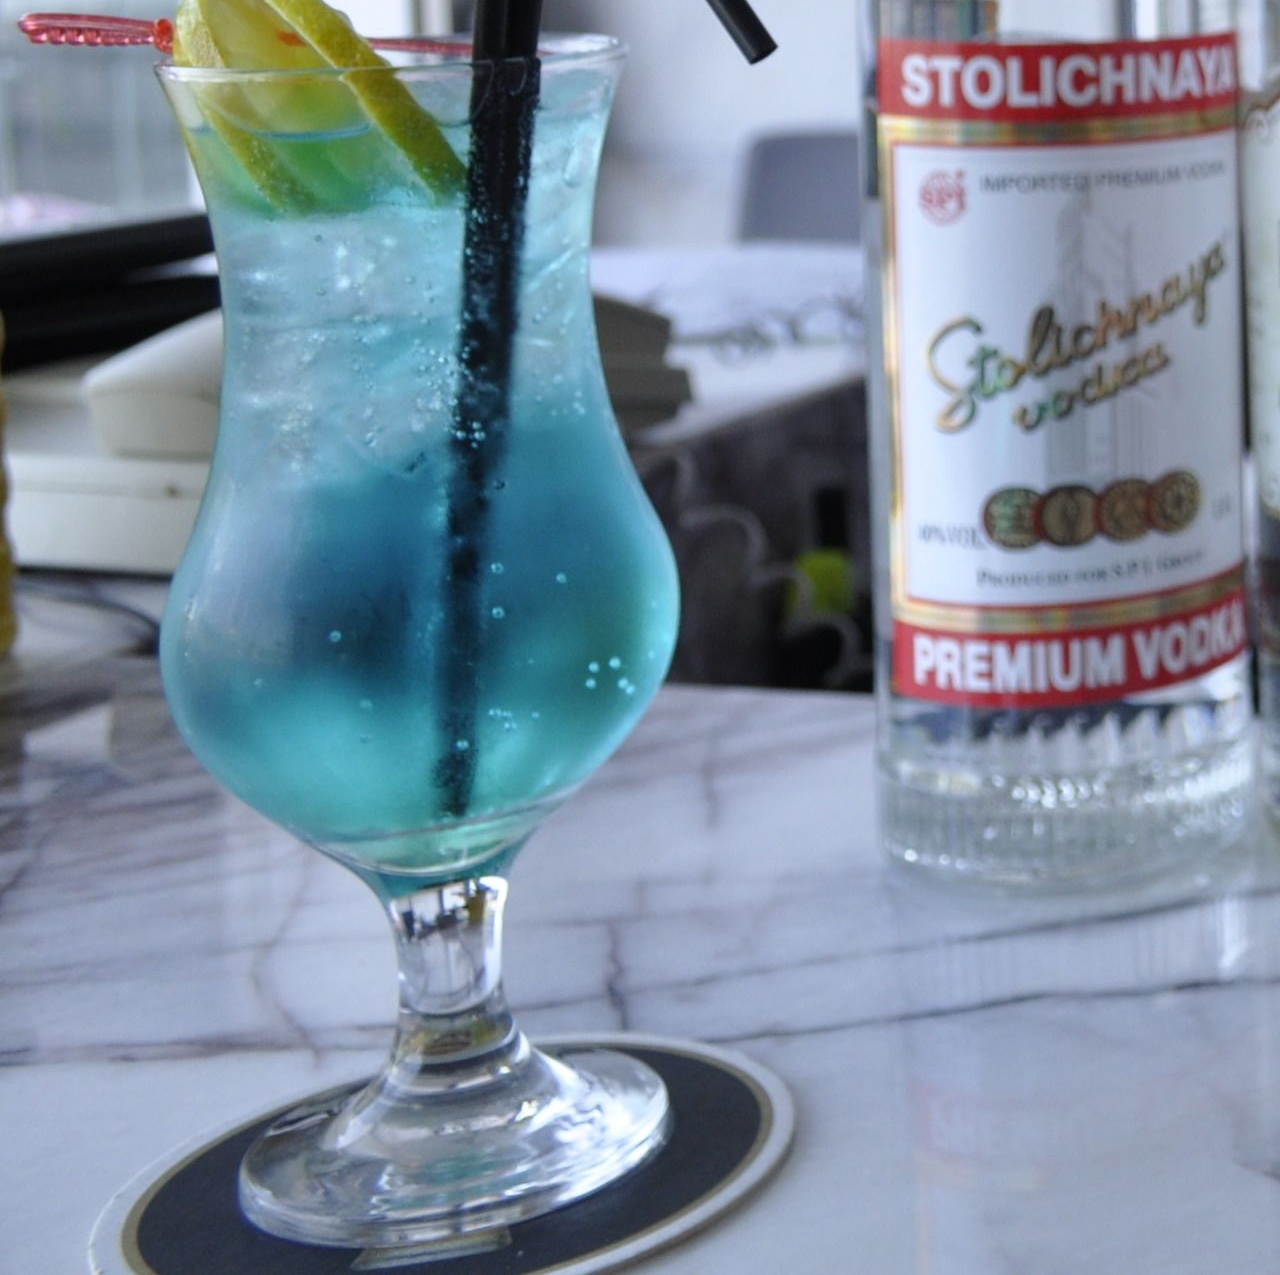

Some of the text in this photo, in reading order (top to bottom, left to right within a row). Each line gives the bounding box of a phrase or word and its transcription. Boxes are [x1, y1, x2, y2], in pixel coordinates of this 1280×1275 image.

[901, 44, 1236, 109] STOLICHNAYA
[912, 605, 1246, 694] PREMIUM VODKA
